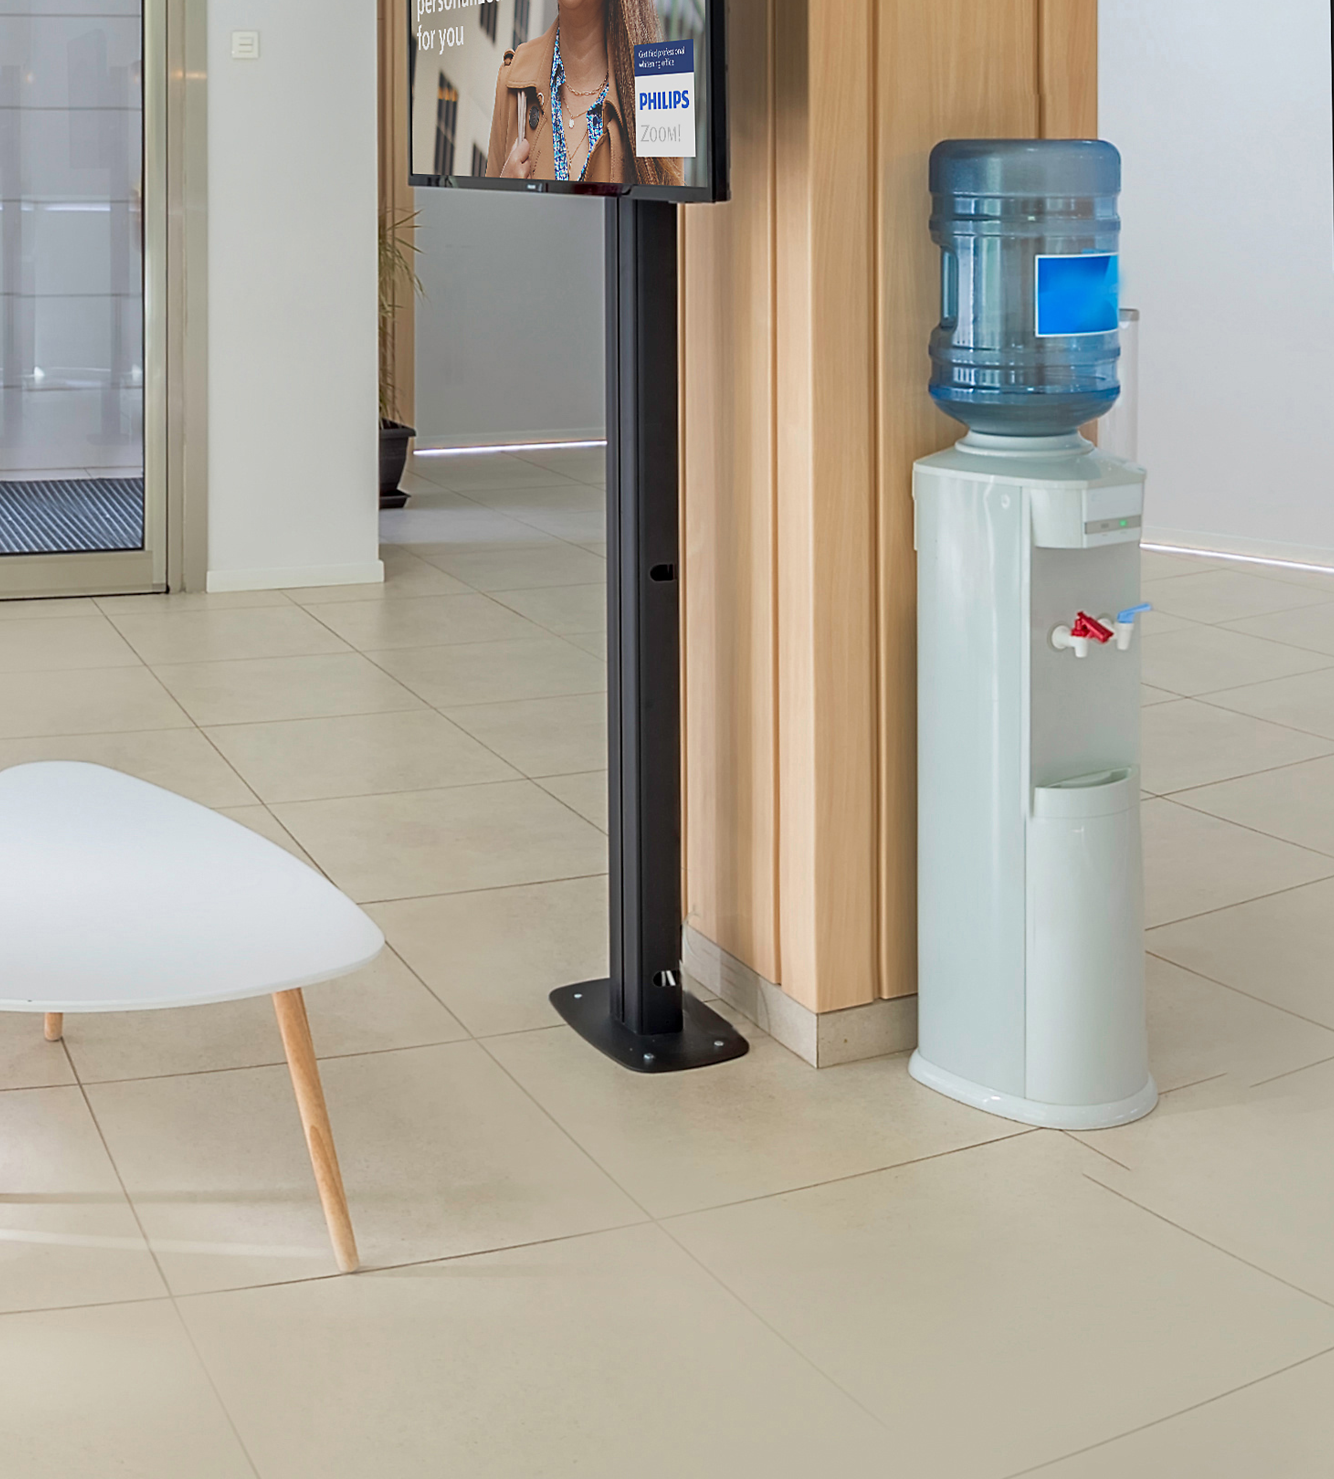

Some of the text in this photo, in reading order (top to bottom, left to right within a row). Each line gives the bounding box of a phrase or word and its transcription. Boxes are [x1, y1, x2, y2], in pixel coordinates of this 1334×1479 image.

[416, 25, 464, 55] for you
[639, 90, 690, 110] PHILIPS
